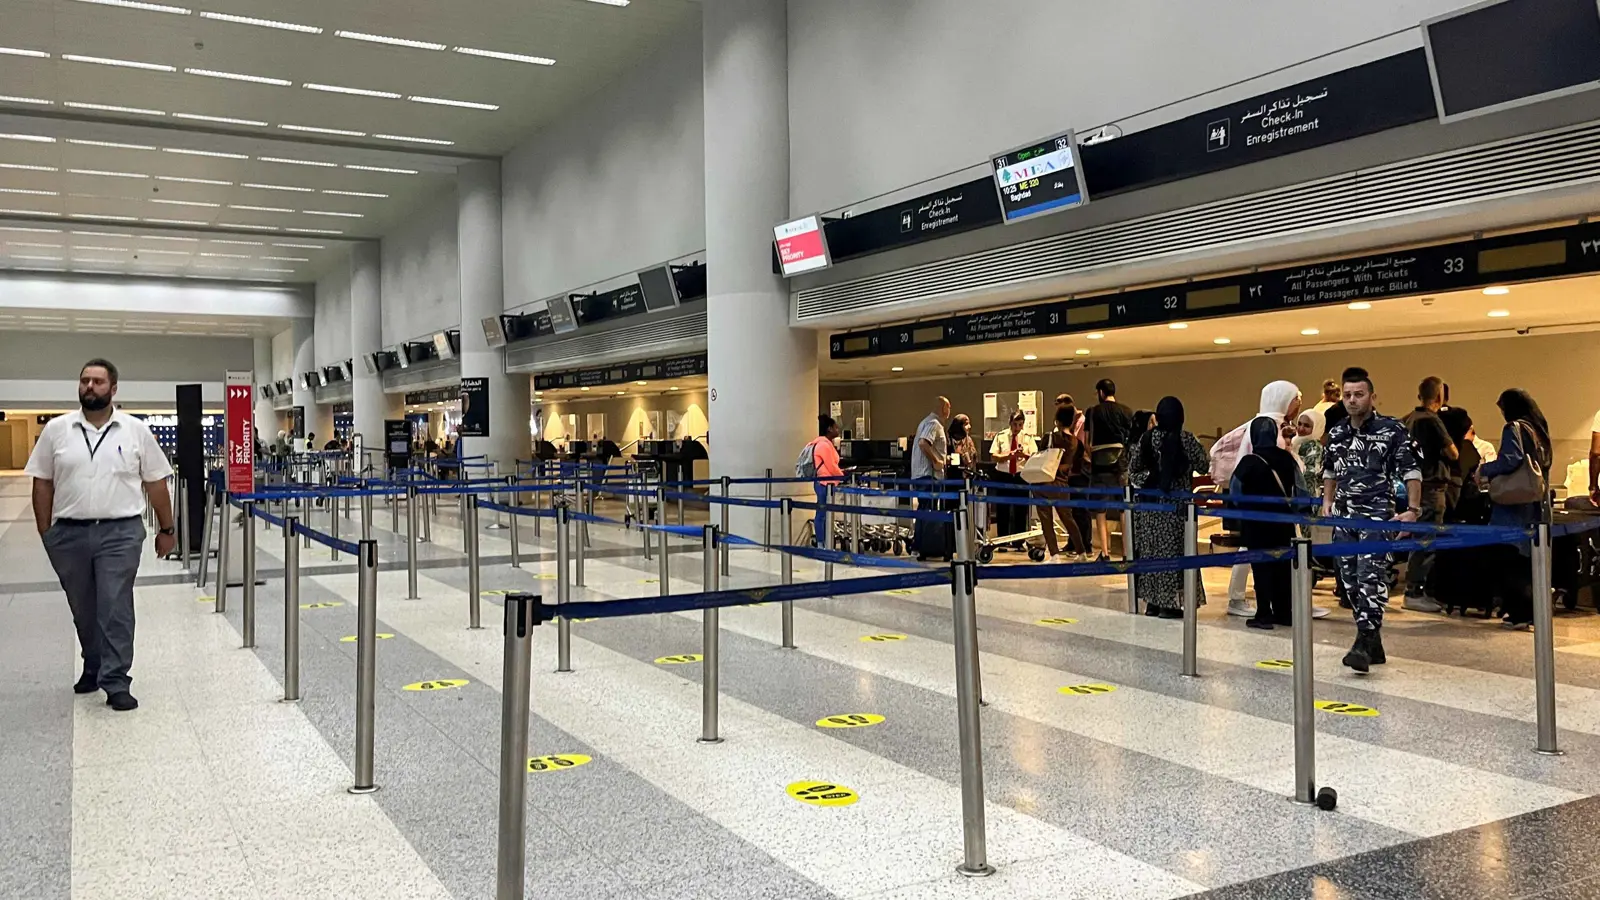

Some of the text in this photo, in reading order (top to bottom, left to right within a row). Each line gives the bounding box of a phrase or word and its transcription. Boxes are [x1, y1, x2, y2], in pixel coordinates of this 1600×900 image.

[1240, 87, 1328, 123] تسجيل تذاكر السفر
[1261, 109, 1303, 128] Check-In
[1246, 118, 1319, 146] Enregistrement
[1057, 139, 1067, 149] 32
[1018, 151, 1031, 160] Open
[997, 159, 1006, 168] 31
[1014, 161, 1055, 180] MEA
[1019, 182, 1029, 190] ME
[1010, 190, 1031, 202] Baghdad
[921, 213, 959, 231] Enregistrement
[1352, 257, 1392, 273] المسافرين
[1393, 256, 1417, 267] جميع
[1443, 257, 1464, 274] 33
[1326, 264, 1351, 277] حاملي
[1291, 268, 1408, 290] All Passengers With Tickets
[1283, 295, 1300, 304] Tous
[1319, 288, 1359, 299] Passagers
[1363, 285, 1385, 294] Avec
[1389, 280, 1418, 291] Billets
[1164, 296, 1178, 309] 32
[1049, 312, 1059, 324] 31
[900, 333, 909, 343] 30
